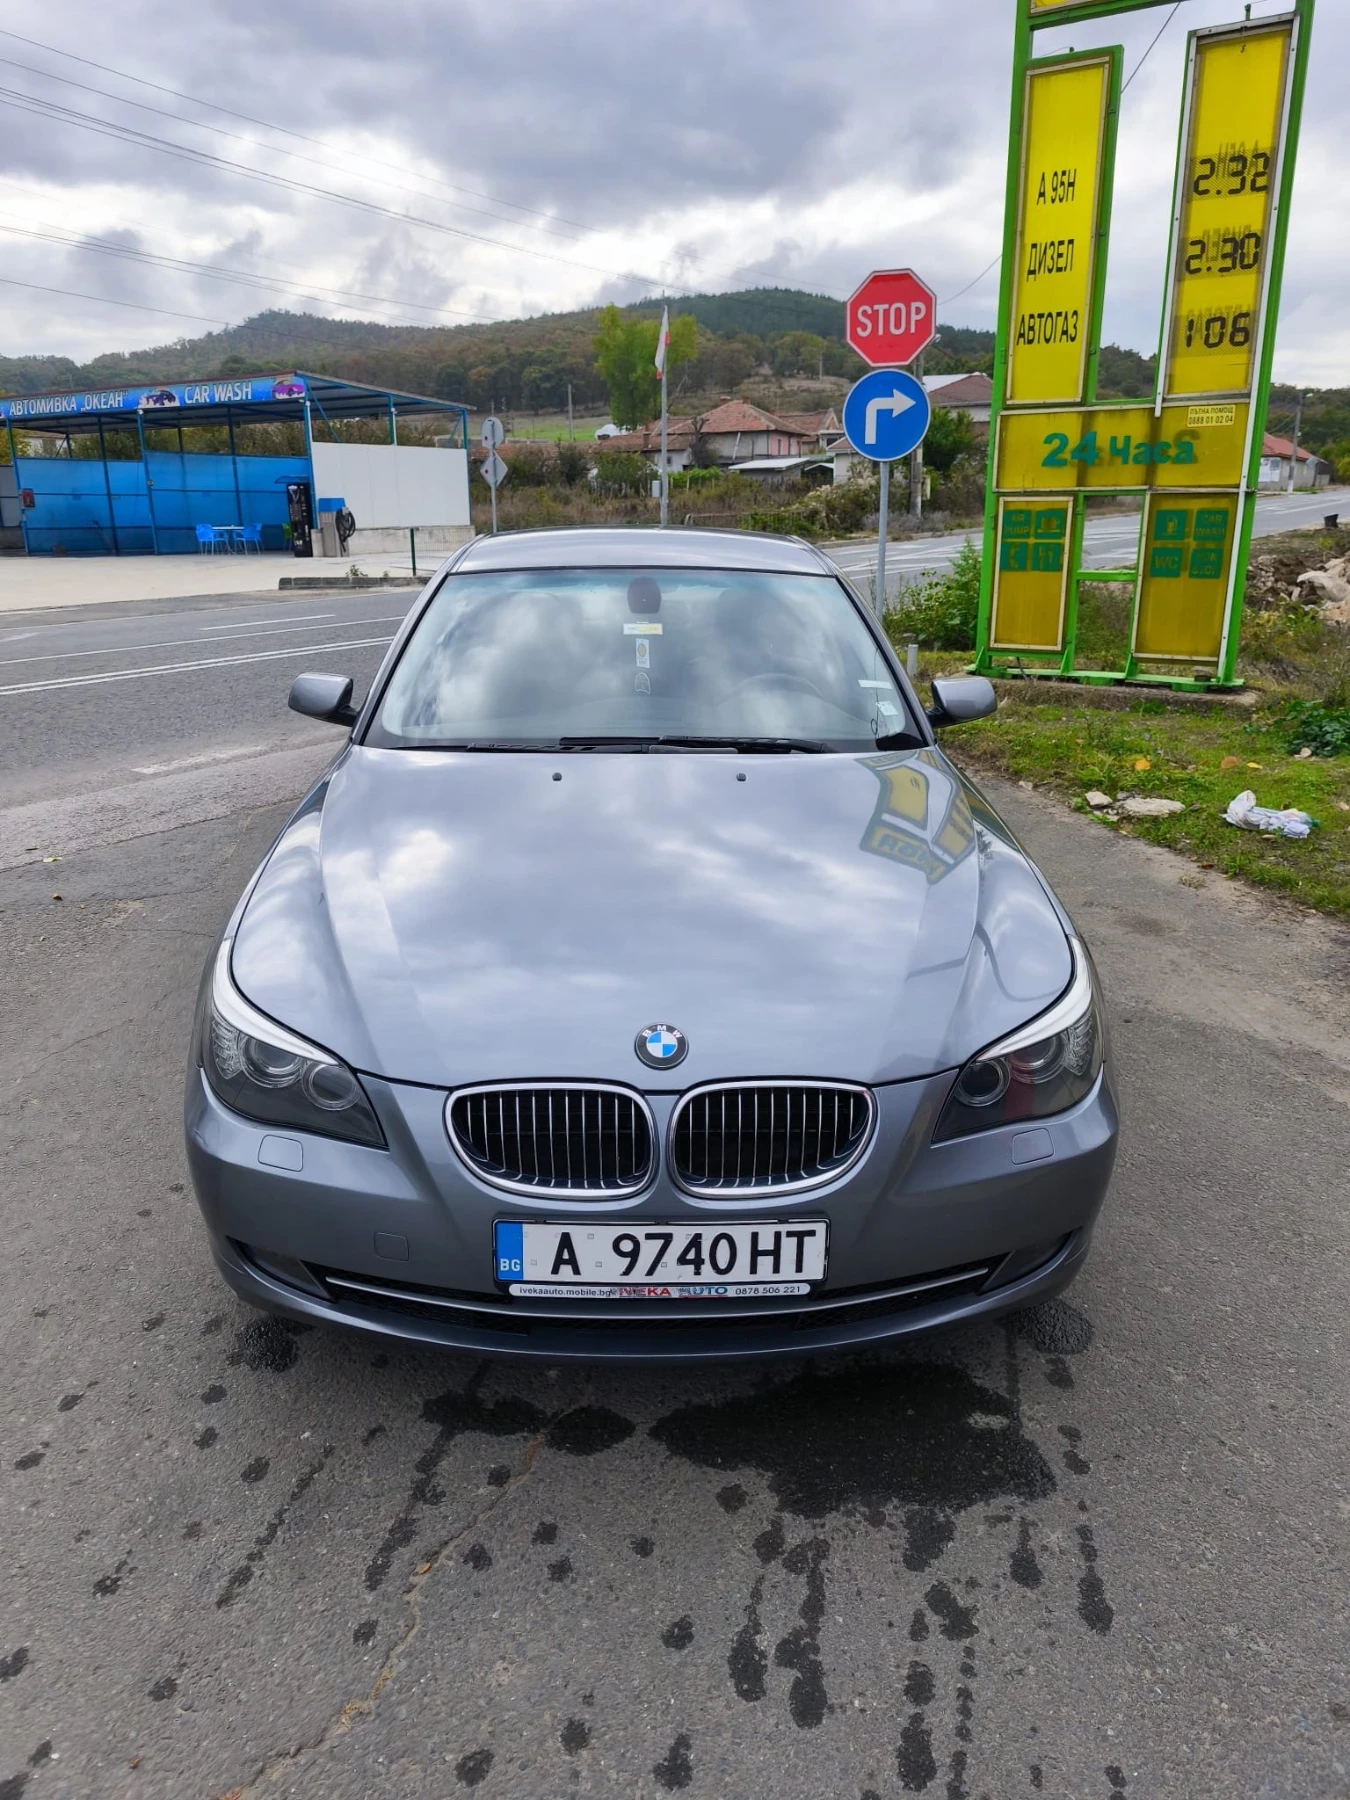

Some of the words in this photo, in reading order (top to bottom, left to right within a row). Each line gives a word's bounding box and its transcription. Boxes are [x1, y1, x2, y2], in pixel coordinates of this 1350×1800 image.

[1193, 152, 1270, 195] 2.32
[1026, 238, 1075, 282] ДИЗЕЛ
[1185, 232, 1260, 274] 2.30
[856, 301, 926, 338] STOP
[1016, 309, 1079, 346] АВТОГАЗ
[9, 396, 77, 416] АВТОМИВКА
[184, 385, 210, 404] CAR
[213, 381, 252, 402] WASH
[1205, 416, 1214, 424] 01
[1215, 415, 1224, 424] 02
[1225, 415, 1233, 423] 04
[1041, 431, 1100, 468] 24
[1154, 556, 1179, 569] WC
[641, 1024, 683, 1038] BMW
[500, 1258, 521, 1272] BG
[551, 1232, 581, 1275] A
[735, 1287, 760, 1295] 0878
[783, 1285, 801, 1293] 221
